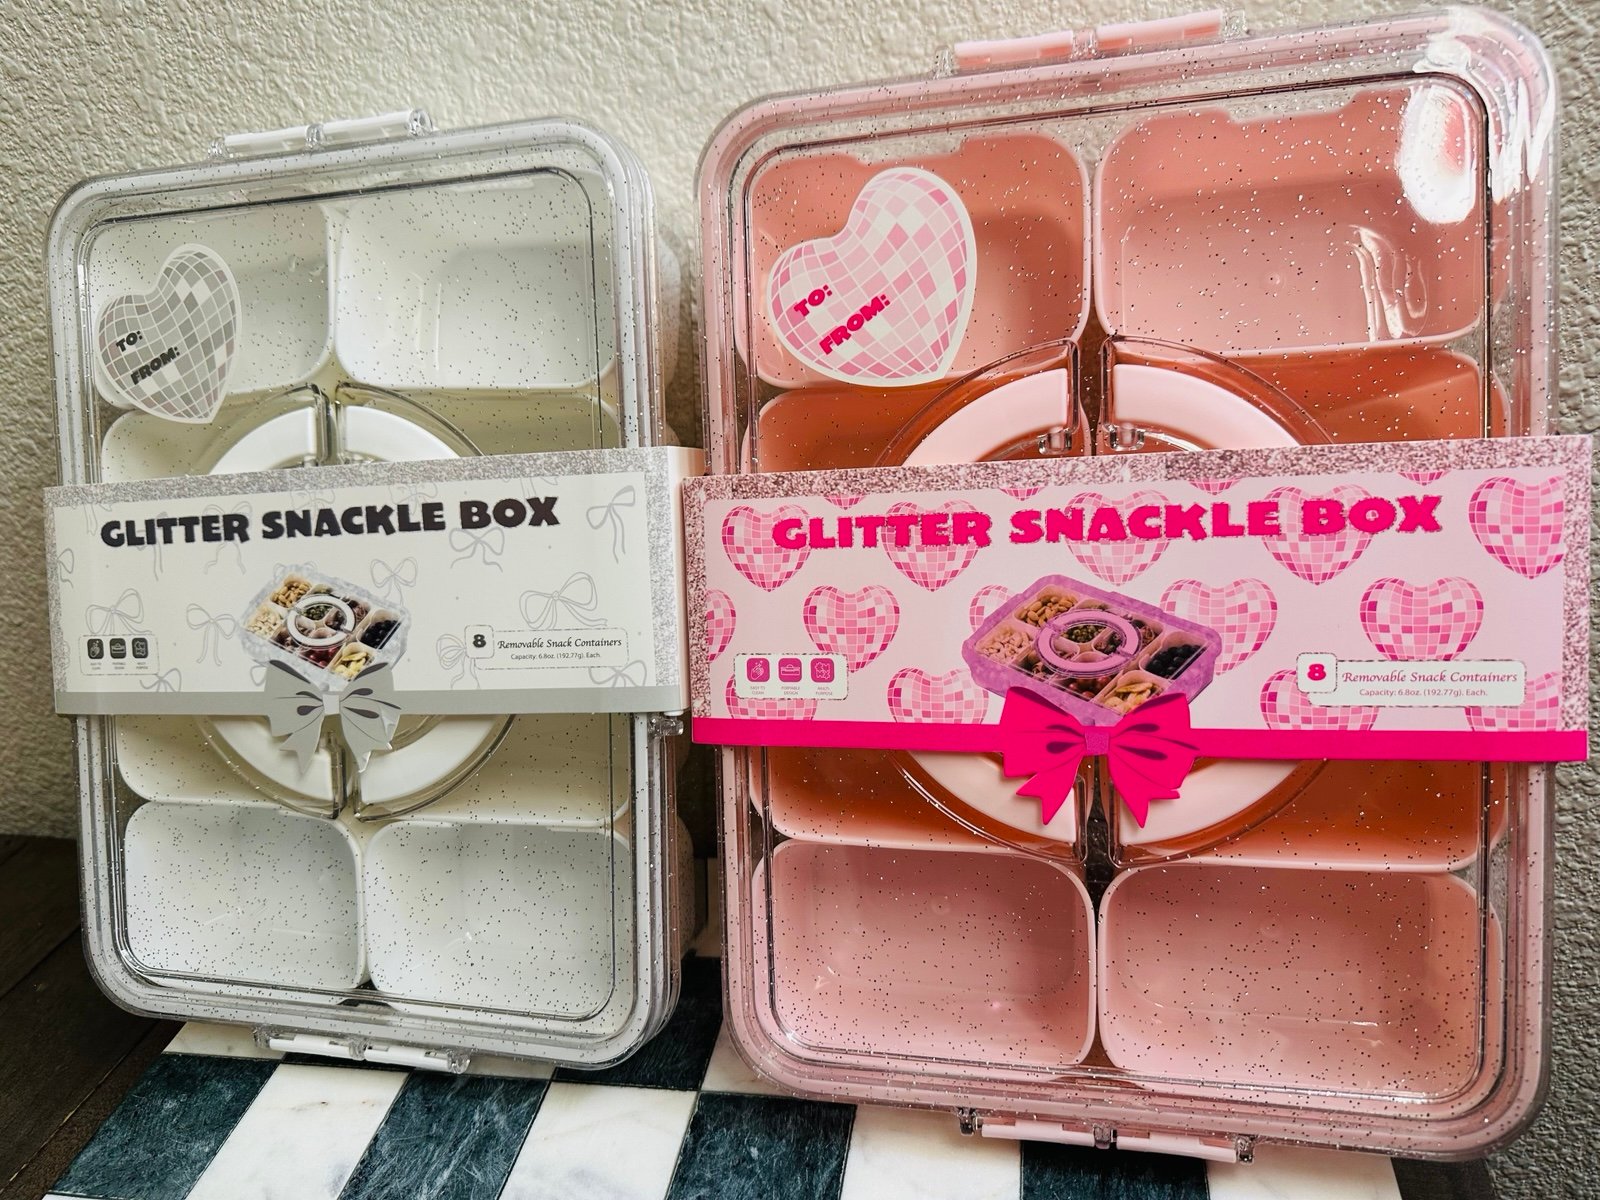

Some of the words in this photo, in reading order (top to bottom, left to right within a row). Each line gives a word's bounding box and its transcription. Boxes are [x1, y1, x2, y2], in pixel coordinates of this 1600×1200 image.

[793, 284, 833, 317] TO:
[819, 294, 891, 355] FROM:
[115, 330, 143, 352] TO:
[130, 346, 180, 385] FROM:
[100, 513, 250, 548] GLITTER
[261, 501, 447, 540] SNACKLE
[459, 496, 560, 530] BOX
[772, 511, 993, 549] GLITTER
[1009, 501, 1281, 543] SNACKLE
[1299, 495, 1443, 535] BOX
[472, 633, 487, 649] 8
[497, 638, 544, 649] Removable
[546, 637, 572, 648] Snack
[574, 638, 622, 647] Containers
[1307, 663, 1327, 681] 8
[1342, 670, 1406, 683] Removable
[1410, 670, 1446, 682] Snack
[1450, 671, 1518, 682] Containers
[1359, 688, 1397, 697] Capacity:
[1397, 688, 1422, 696] 6.8oz.
[1423, 688, 1464, 698] (192.77g).
[1465, 688, 1489, 696] Each.
